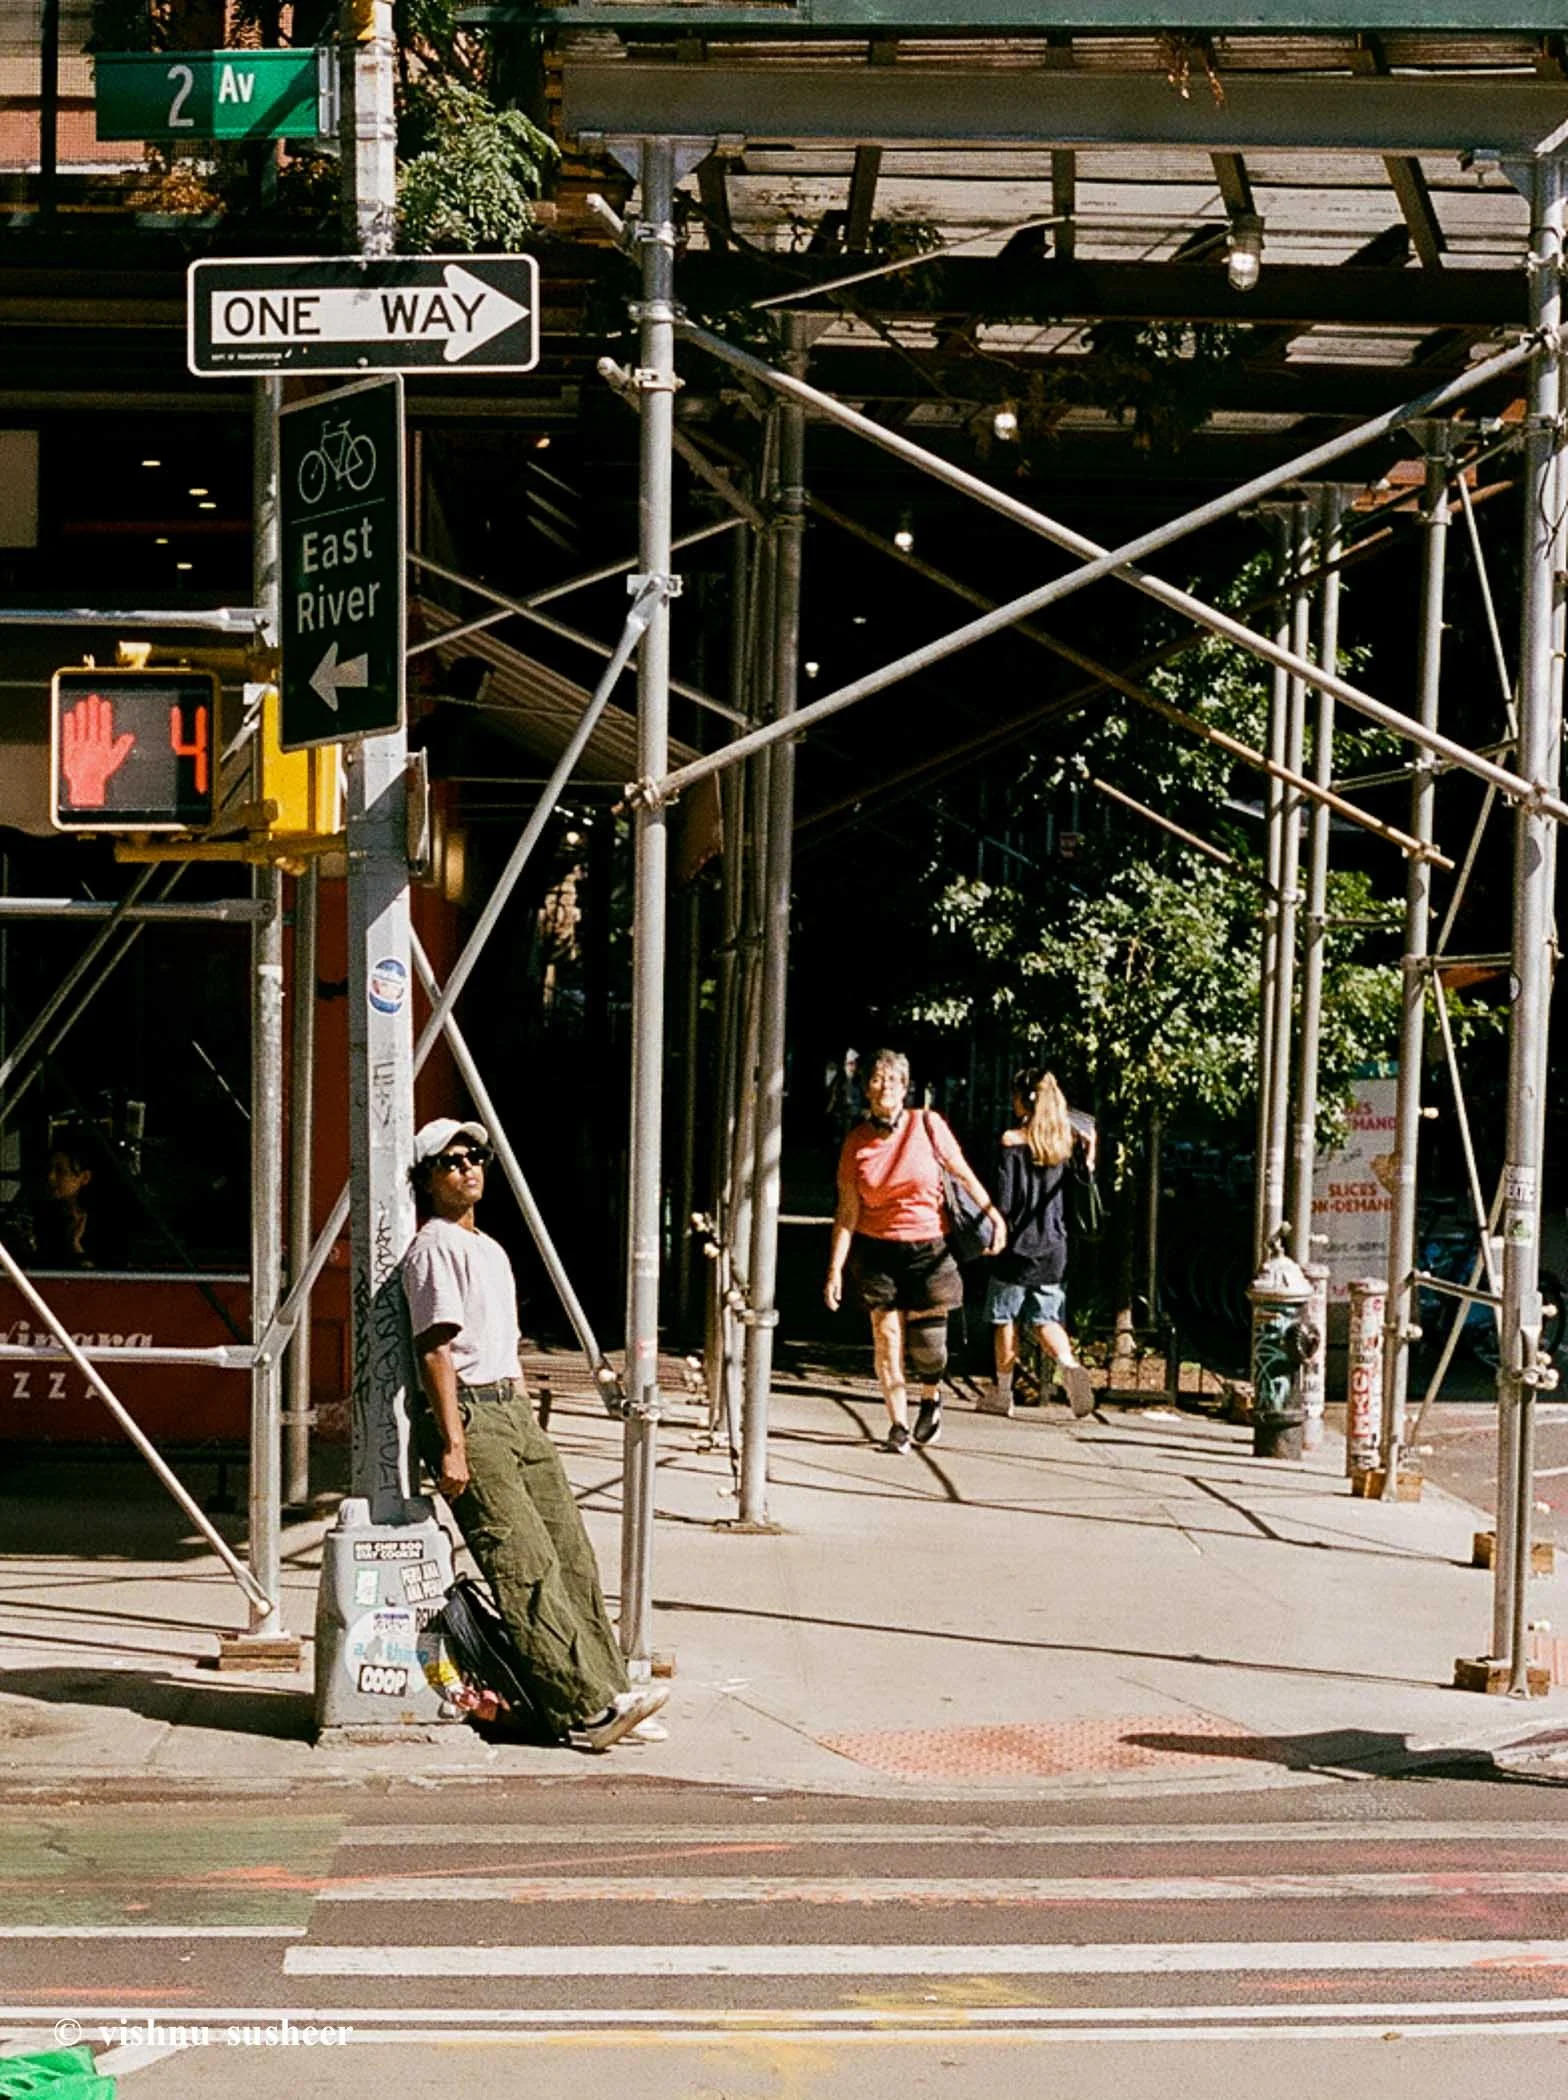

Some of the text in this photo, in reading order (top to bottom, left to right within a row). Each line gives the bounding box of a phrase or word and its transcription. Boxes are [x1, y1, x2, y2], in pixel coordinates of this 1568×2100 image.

[167, 63, 255, 128] 2 Av
[224, 293, 487, 337] ONE WAY
[302, 516, 374, 574] East
[297, 581, 381, 635] River
[169, 705, 208, 794] 4
[1328, 1183, 1377, 1197] SLICES
